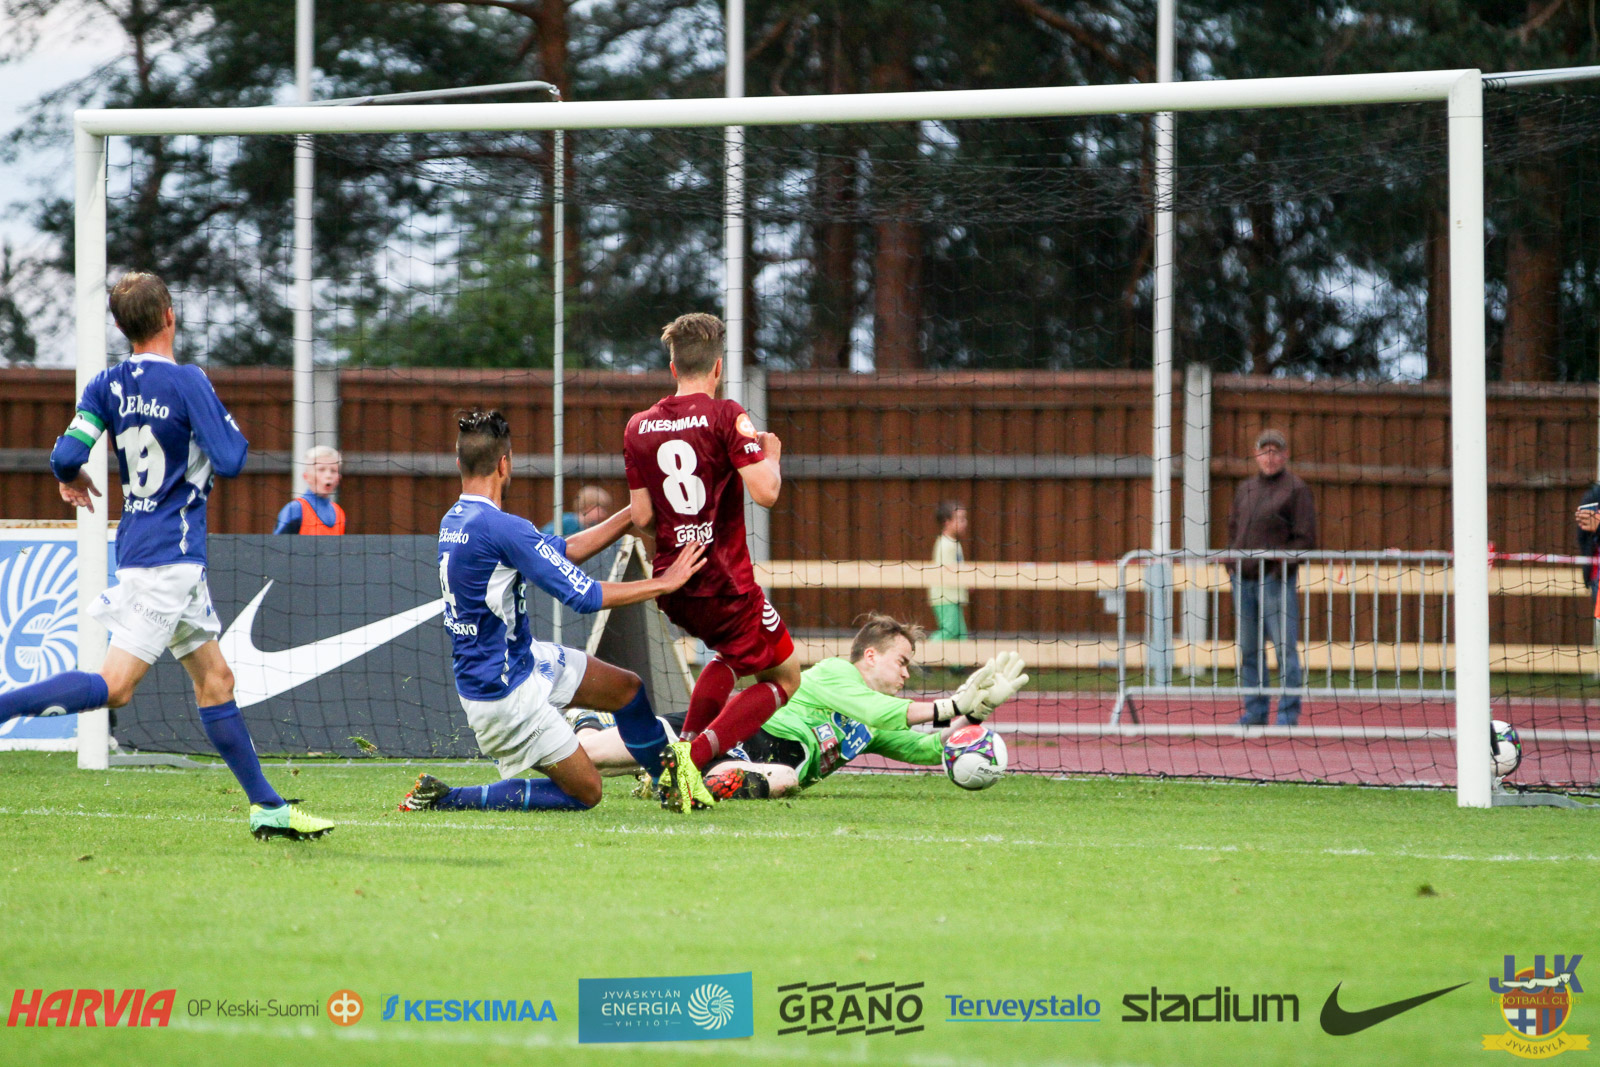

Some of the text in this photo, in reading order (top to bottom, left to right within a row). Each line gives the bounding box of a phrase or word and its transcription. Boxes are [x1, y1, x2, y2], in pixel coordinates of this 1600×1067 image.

[115, 424, 166, 498] 19
[656, 439, 707, 516] 8
[439, 551, 458, 620] 4
[534, 538, 595, 596] FRESSI
[142, 608, 175, 632] MAMK
